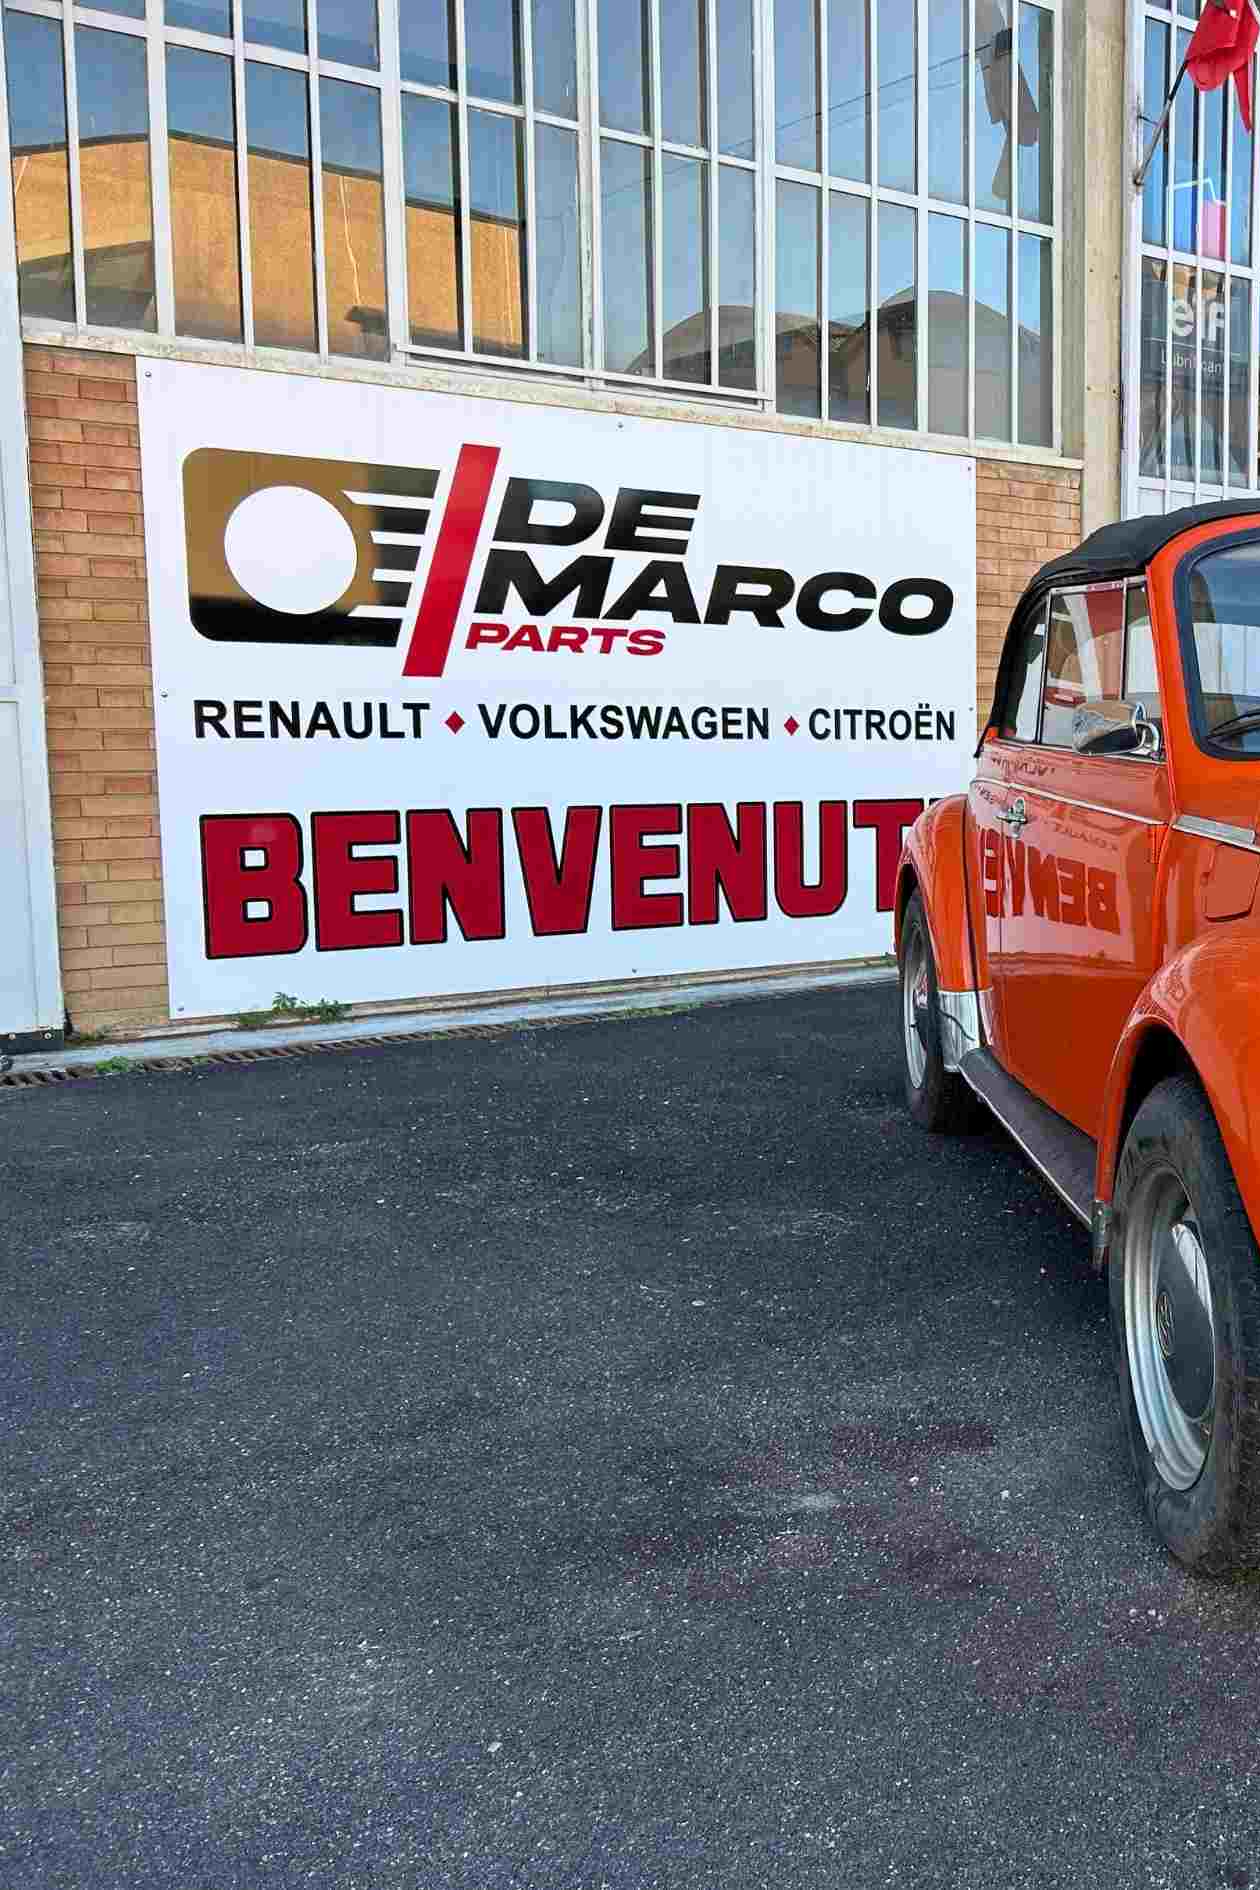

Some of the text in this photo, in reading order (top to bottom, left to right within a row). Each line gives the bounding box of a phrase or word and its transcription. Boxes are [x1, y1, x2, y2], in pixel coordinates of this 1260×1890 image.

[492, 476, 701, 556] DE
[473, 547, 954, 637] MARCO
[465, 622, 666, 657] PARTS
[193, 699, 956, 741] RENAULT VOLKSWAGEN CITROËN
[199, 797, 944, 961] BENVENUT
